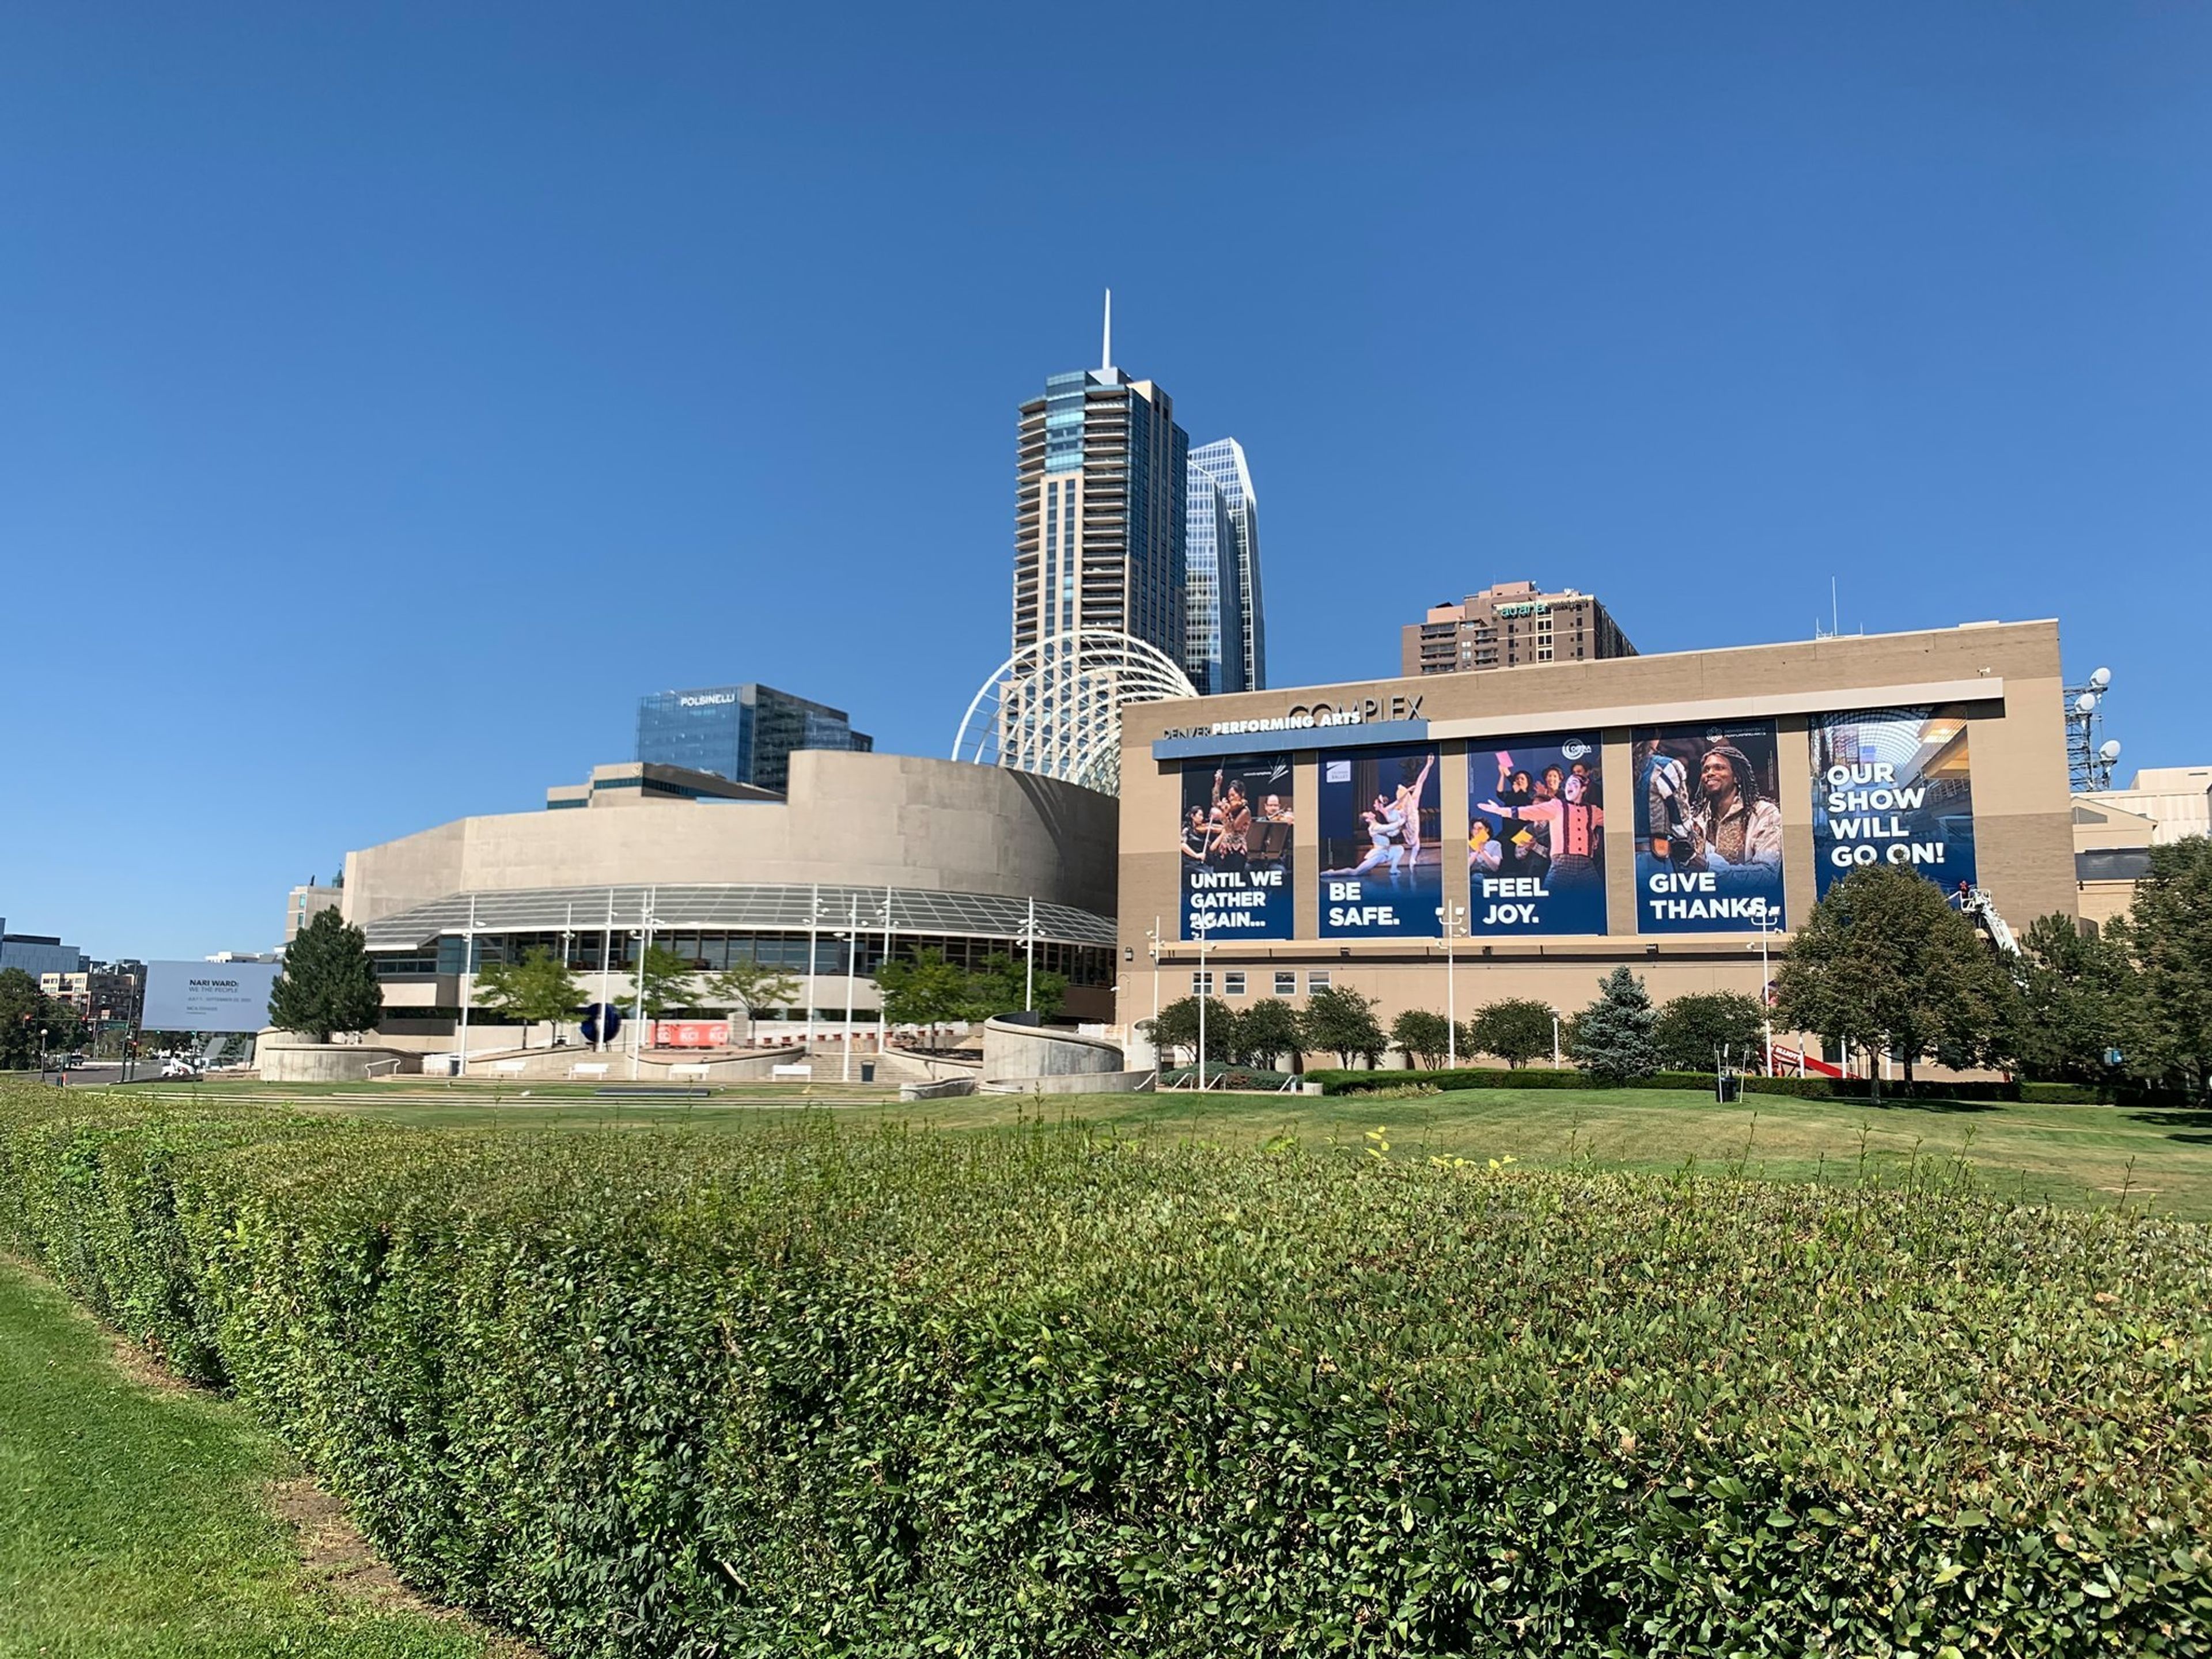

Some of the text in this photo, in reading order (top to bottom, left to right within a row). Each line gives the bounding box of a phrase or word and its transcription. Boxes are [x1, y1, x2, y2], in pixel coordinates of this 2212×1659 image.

[681, 694, 735, 707] POLSINELLI
[1163, 711, 1361, 740] DENVER PERFORMING ARTS
[1827, 763, 1895, 786] OUR
[1828, 787, 1926, 813] SHOW
[1829, 816, 1909, 840] WILL
[1831, 843, 1945, 867] GO ON!
[1191, 870, 1283, 888] UNTIL WE
[1483, 877, 1550, 898] FEEL
[1649, 872, 1716, 893] GIVE
[1190, 891, 1266, 908] GATHER
[1330, 882, 1361, 902] BE
[1329, 906, 1400, 926] SAFE.
[1482, 904, 1539, 925] JOY.
